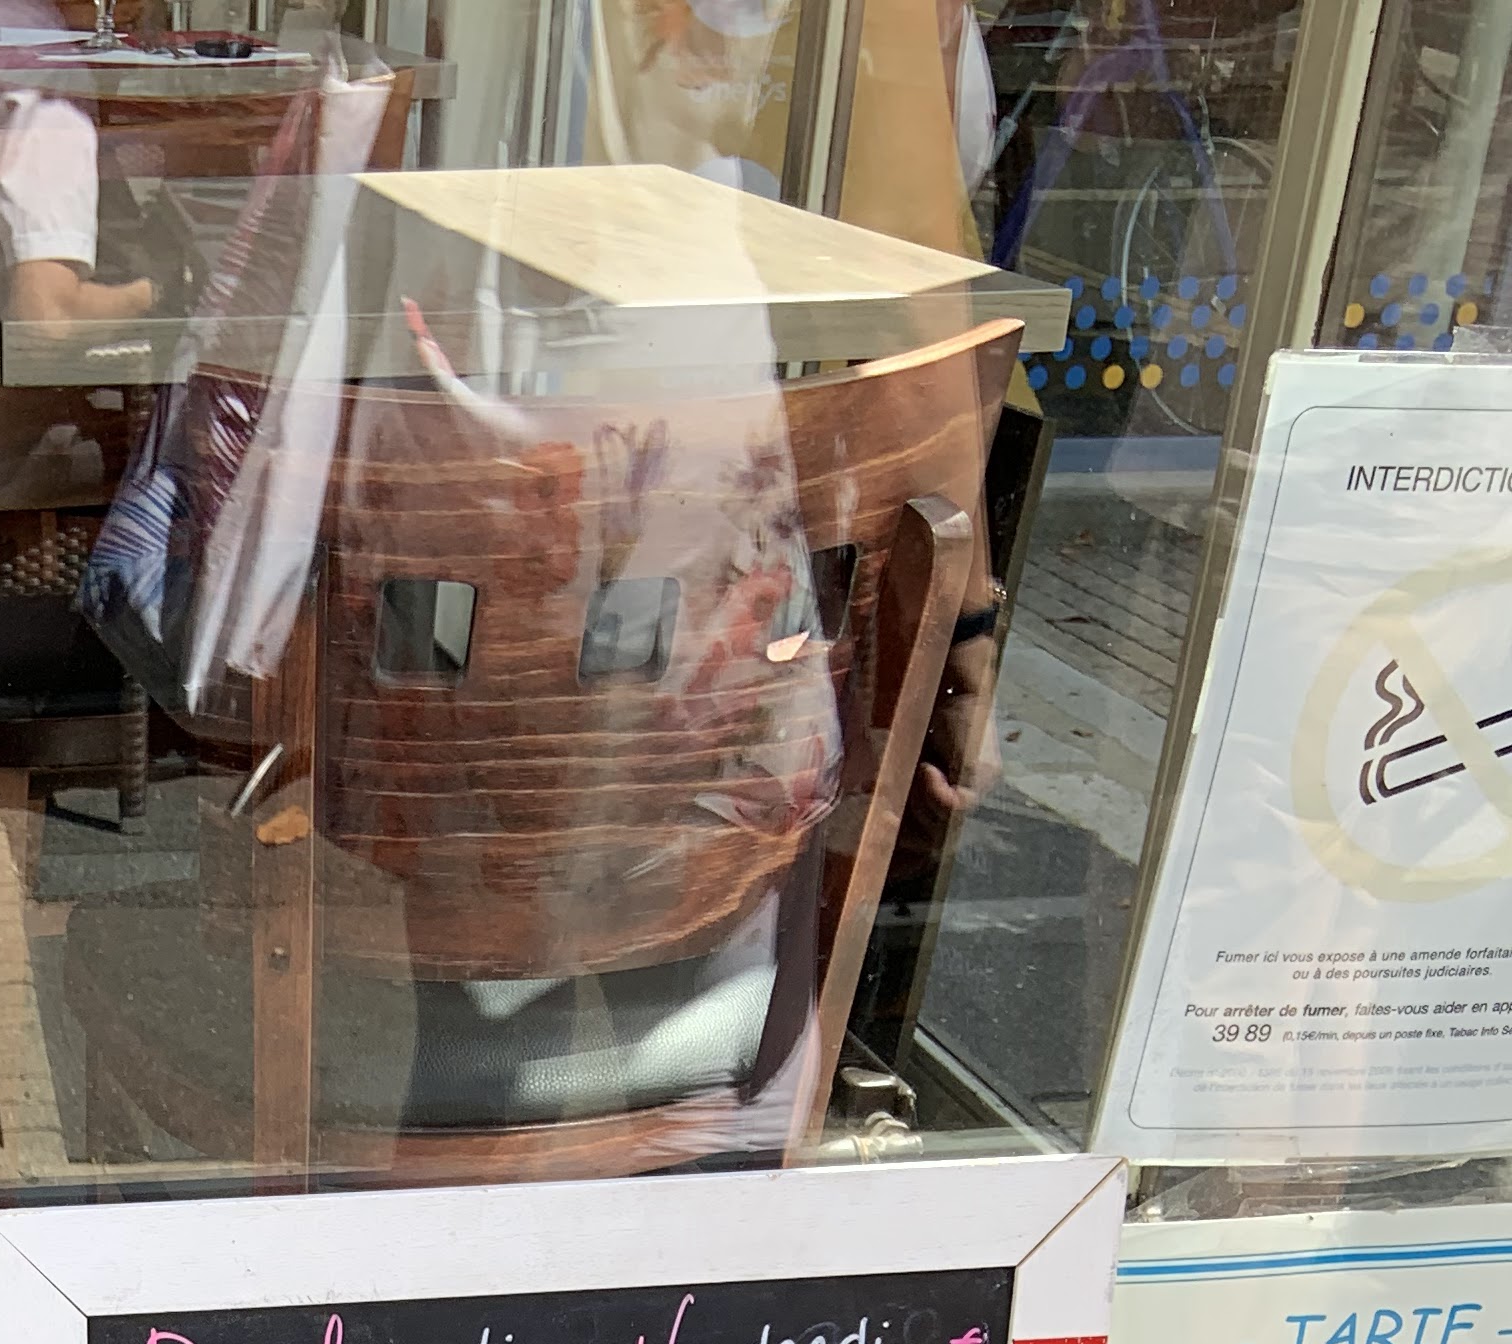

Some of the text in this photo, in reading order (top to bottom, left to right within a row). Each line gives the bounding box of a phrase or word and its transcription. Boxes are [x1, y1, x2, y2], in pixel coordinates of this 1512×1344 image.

[1347, 465, 1512, 492] INTERDICTI
[1215, 951, 1261, 963] Fumer
[1282, 952, 1313, 963] vous
[1318, 951, 1365, 965] expose
[1382, 951, 1406, 962] une
[1410, 948, 1462, 961] amende
[1292, 970, 1310, 981] ou
[1326, 967, 1350, 980] des
[1353, 966, 1421, 982] poursuites
[1423, 964, 1493, 981] judiciaires.
[1184, 1001, 1488, 1019] Pour arrêter de fumer, faites-vous aider en
[1212, 1024, 1272, 1042] 39 89
